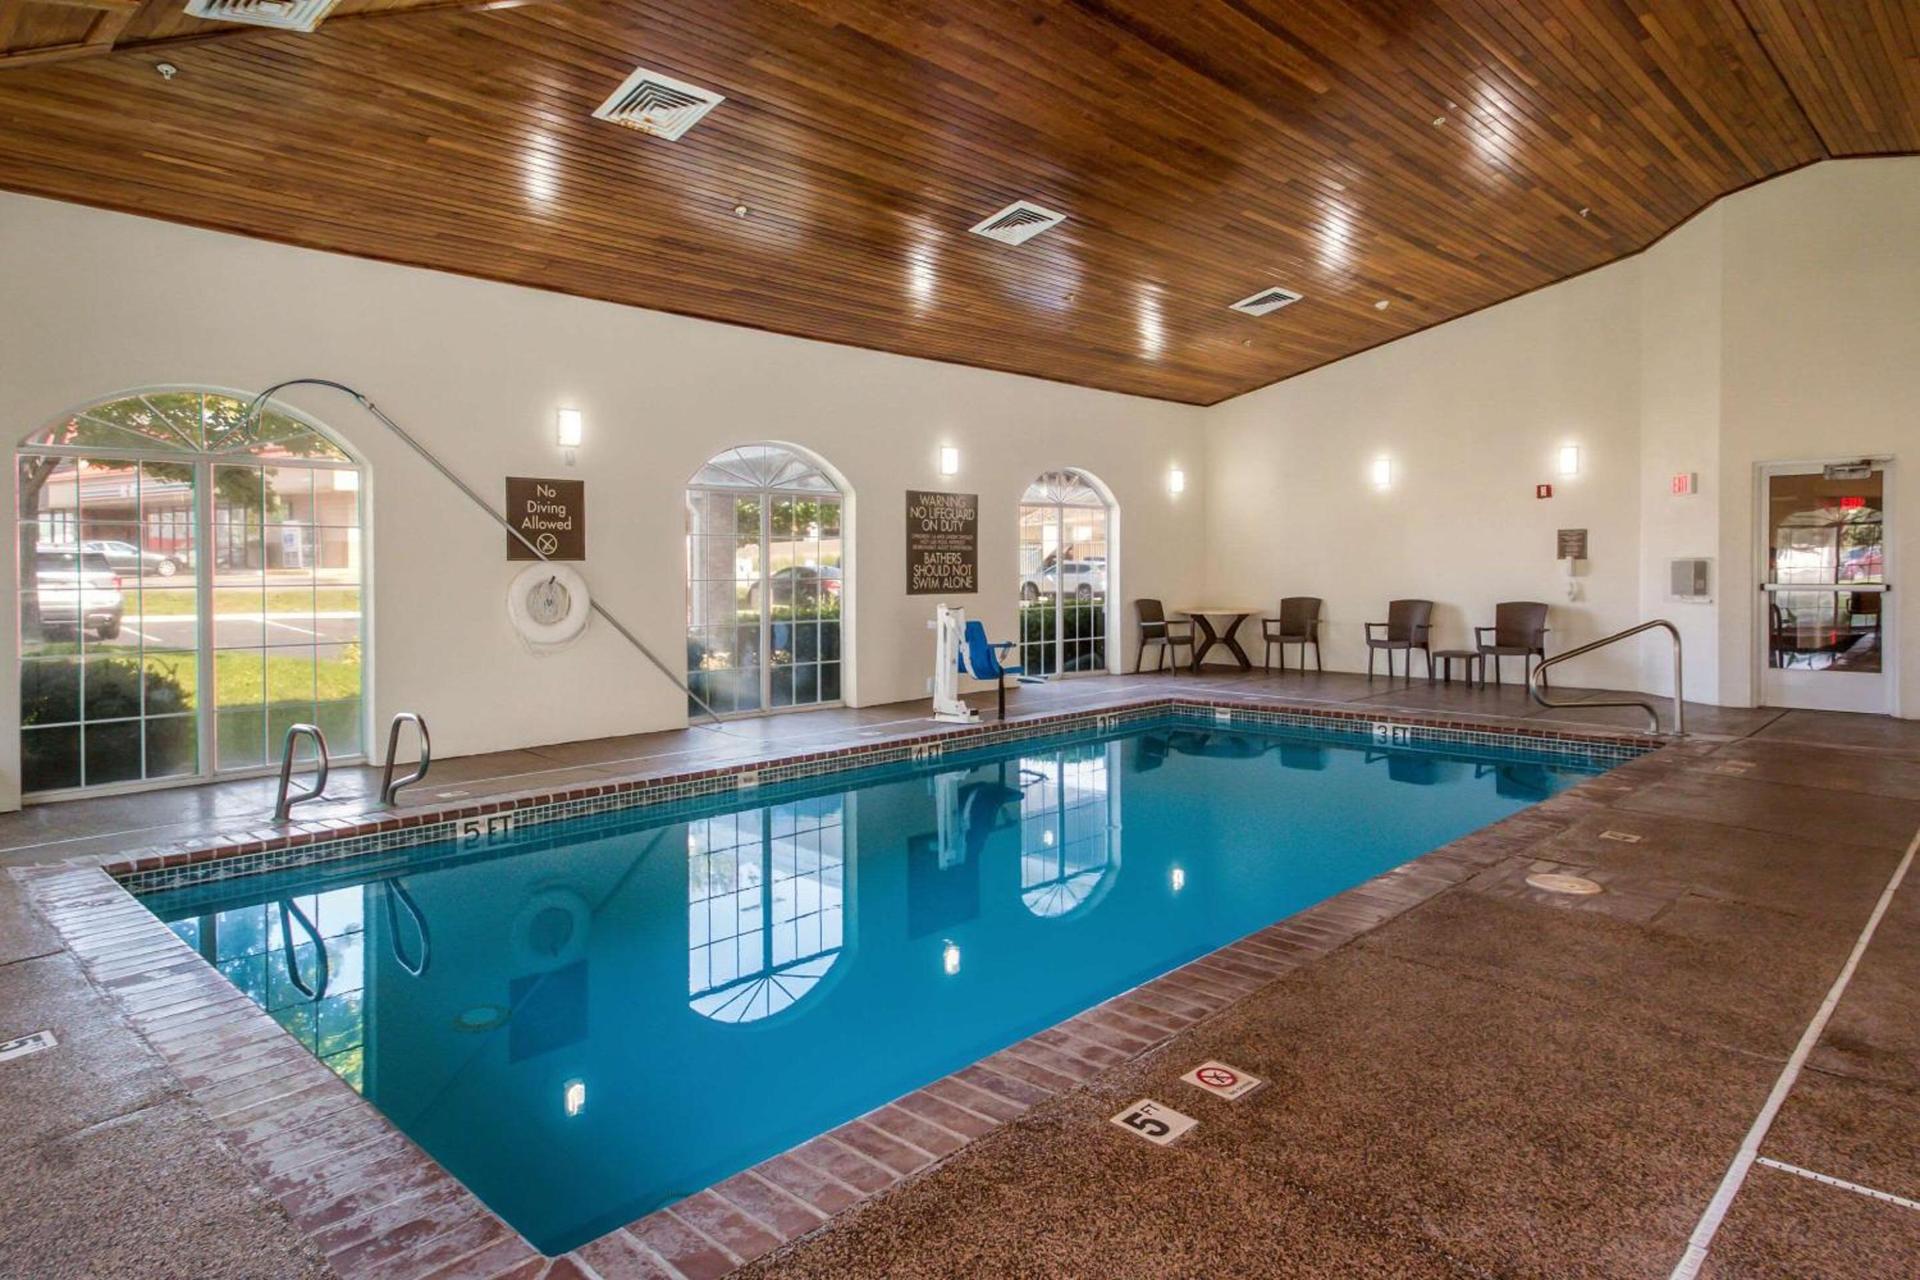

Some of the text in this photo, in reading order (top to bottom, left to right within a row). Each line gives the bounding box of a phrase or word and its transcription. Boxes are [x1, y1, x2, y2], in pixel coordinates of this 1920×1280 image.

[536, 484, 557, 498] No
[920, 495, 967, 508] WARNING
[527, 500, 566, 518] Diving
[910, 506, 975, 521] NO LIFEGUARD
[521, 515, 572, 531] Allowed
[921, 519, 965, 532] ON DUTY
[924, 552, 962, 565] BATHERS
[913, 564, 972, 577] SHOULD NOT
[913, 577, 973, 590] SWIM ALONE
[1377, 724, 1388, 737] 3
[464, 815, 512, 840] 5 FT
[1121, 1112, 1170, 1137] 5
